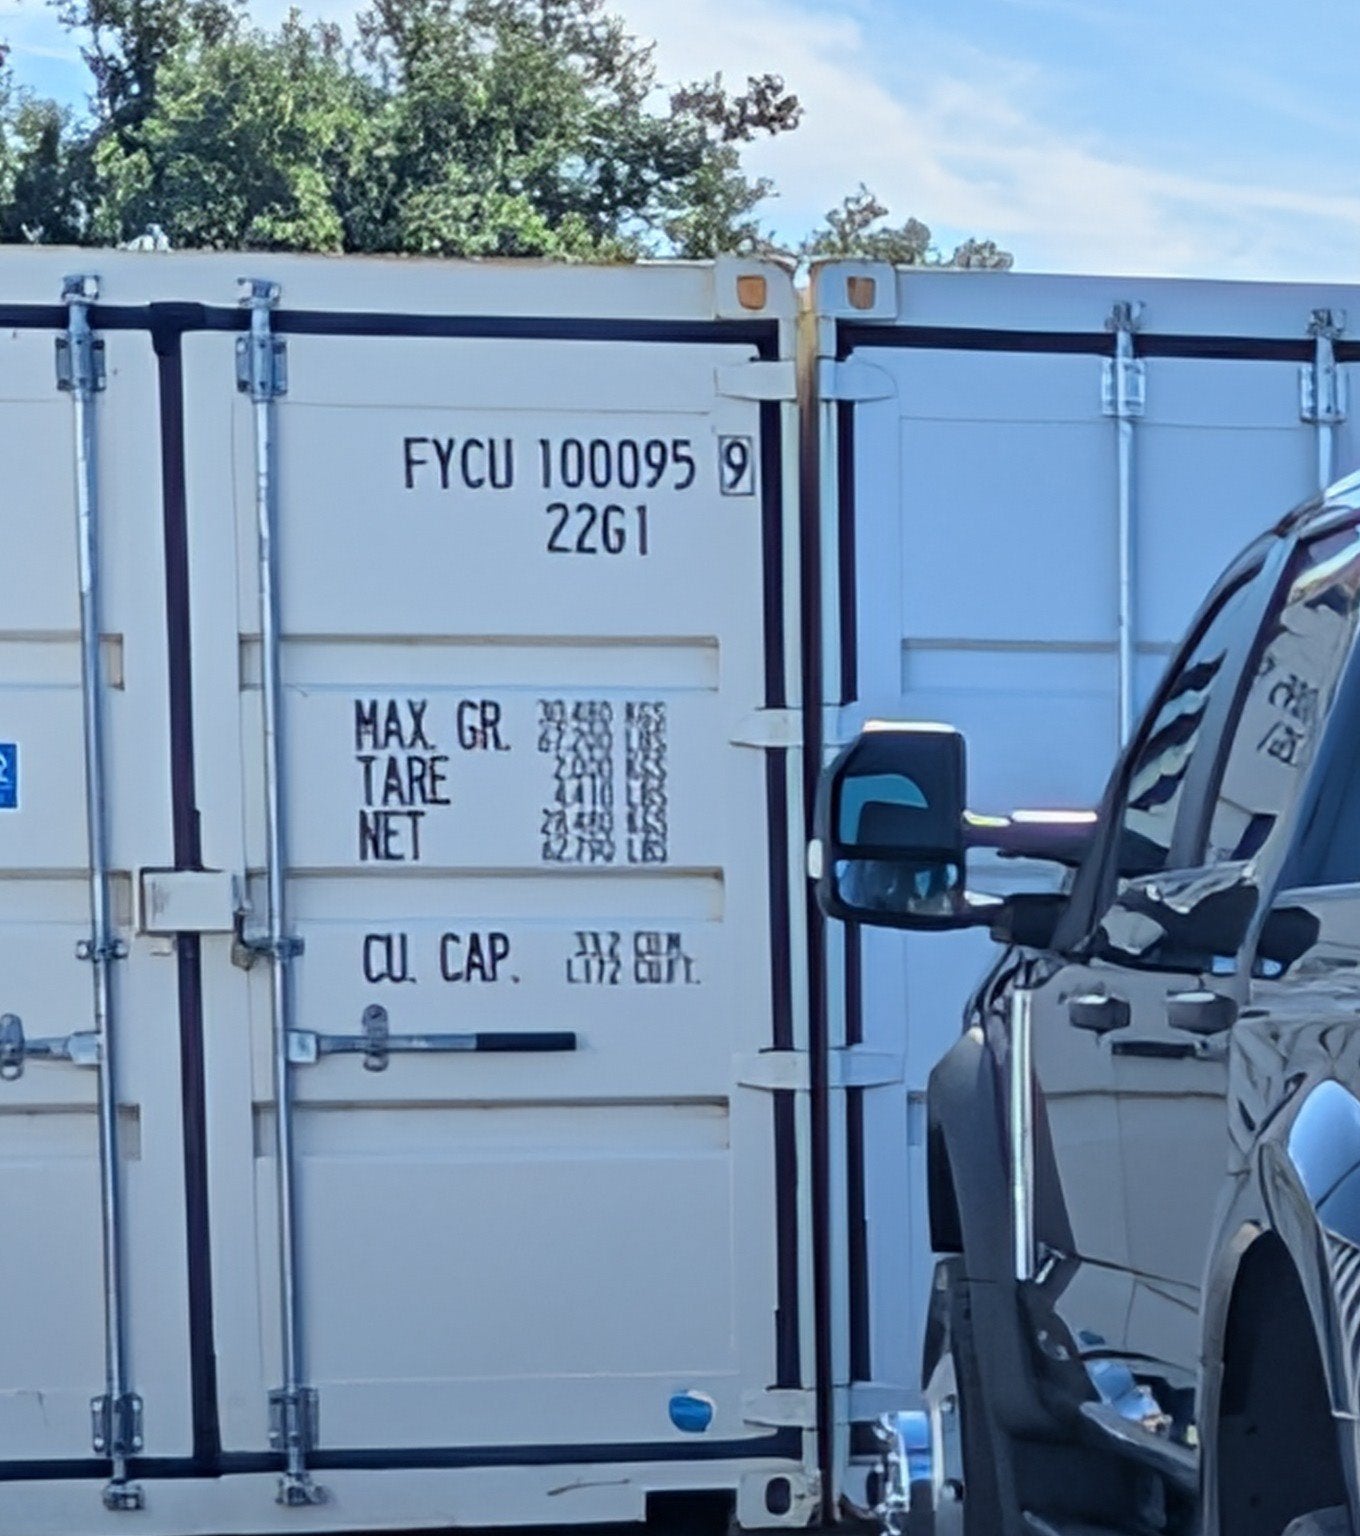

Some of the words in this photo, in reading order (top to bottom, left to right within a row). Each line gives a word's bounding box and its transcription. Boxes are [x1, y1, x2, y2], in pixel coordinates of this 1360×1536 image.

[403, 437, 514, 490] FYCU
[538, 438, 696, 491] 100095
[725, 440, 749, 490] 9
[545, 502, 649, 556] 22G1
[354, 699, 437, 751] MAX.
[456, 699, 511, 751] GR.
[356, 754, 451, 806] TARE
[358, 809, 426, 861] NET
[439, 931, 520, 984] CAP.
